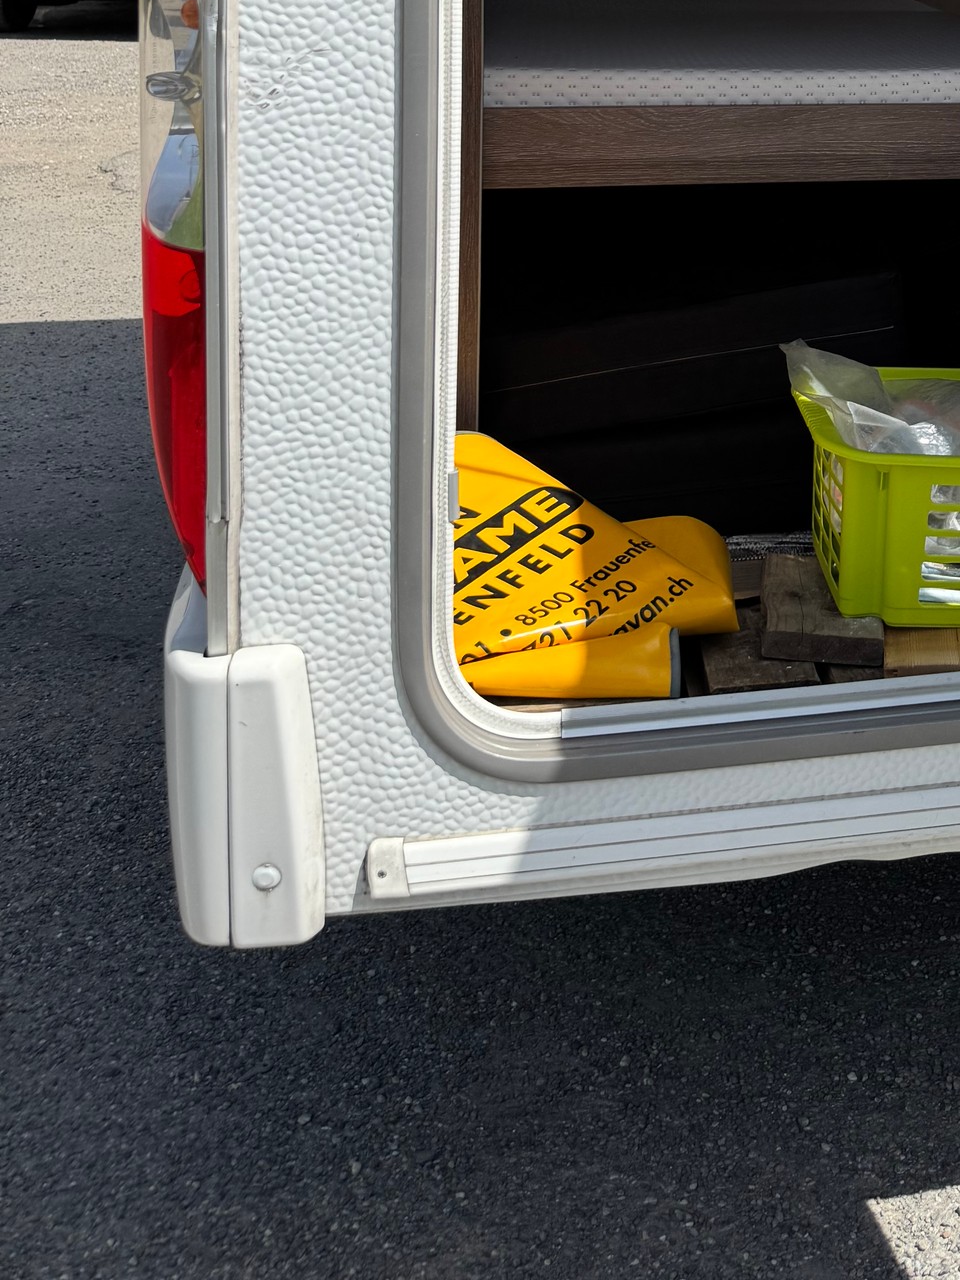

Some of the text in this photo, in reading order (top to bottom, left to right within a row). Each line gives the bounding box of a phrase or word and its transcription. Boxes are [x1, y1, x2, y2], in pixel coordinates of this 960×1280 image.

[514, 591, 575, 626] 8500
[573, 599, 610, 628] 22
[603, 580, 637, 602] 20
[608, 576, 694, 636] avan.ch
